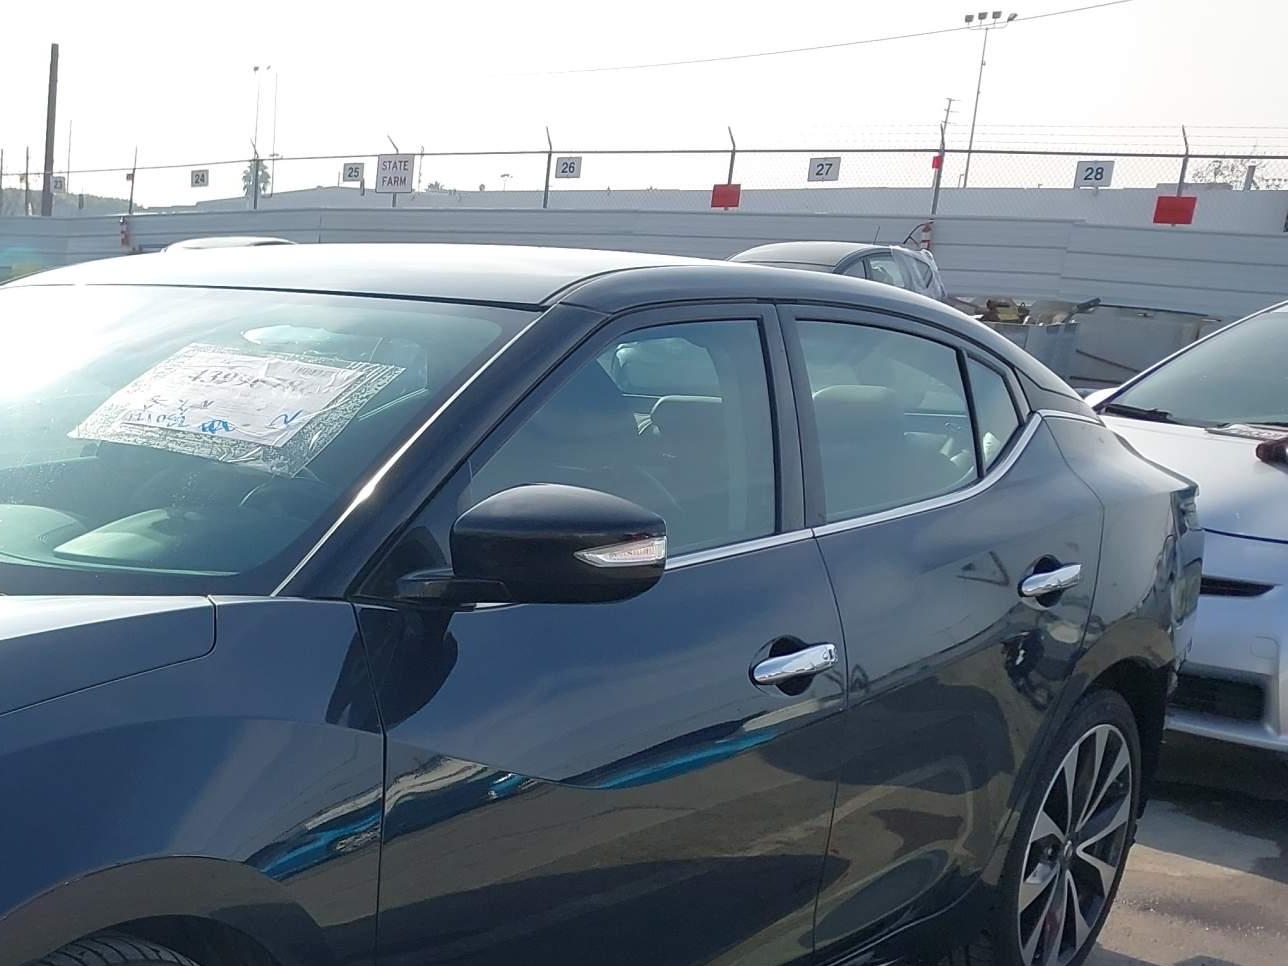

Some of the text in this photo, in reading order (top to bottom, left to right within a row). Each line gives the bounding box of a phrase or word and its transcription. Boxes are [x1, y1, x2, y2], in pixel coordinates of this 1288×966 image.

[382, 160, 409, 171] STATE
[561, 162, 576, 173] 26
[815, 163, 833, 176] 27
[347, 167, 360, 178] 25
[1083, 166, 1105, 181] 28
[194, 173, 205, 184] 24
[381, 176, 407, 186] FARM
